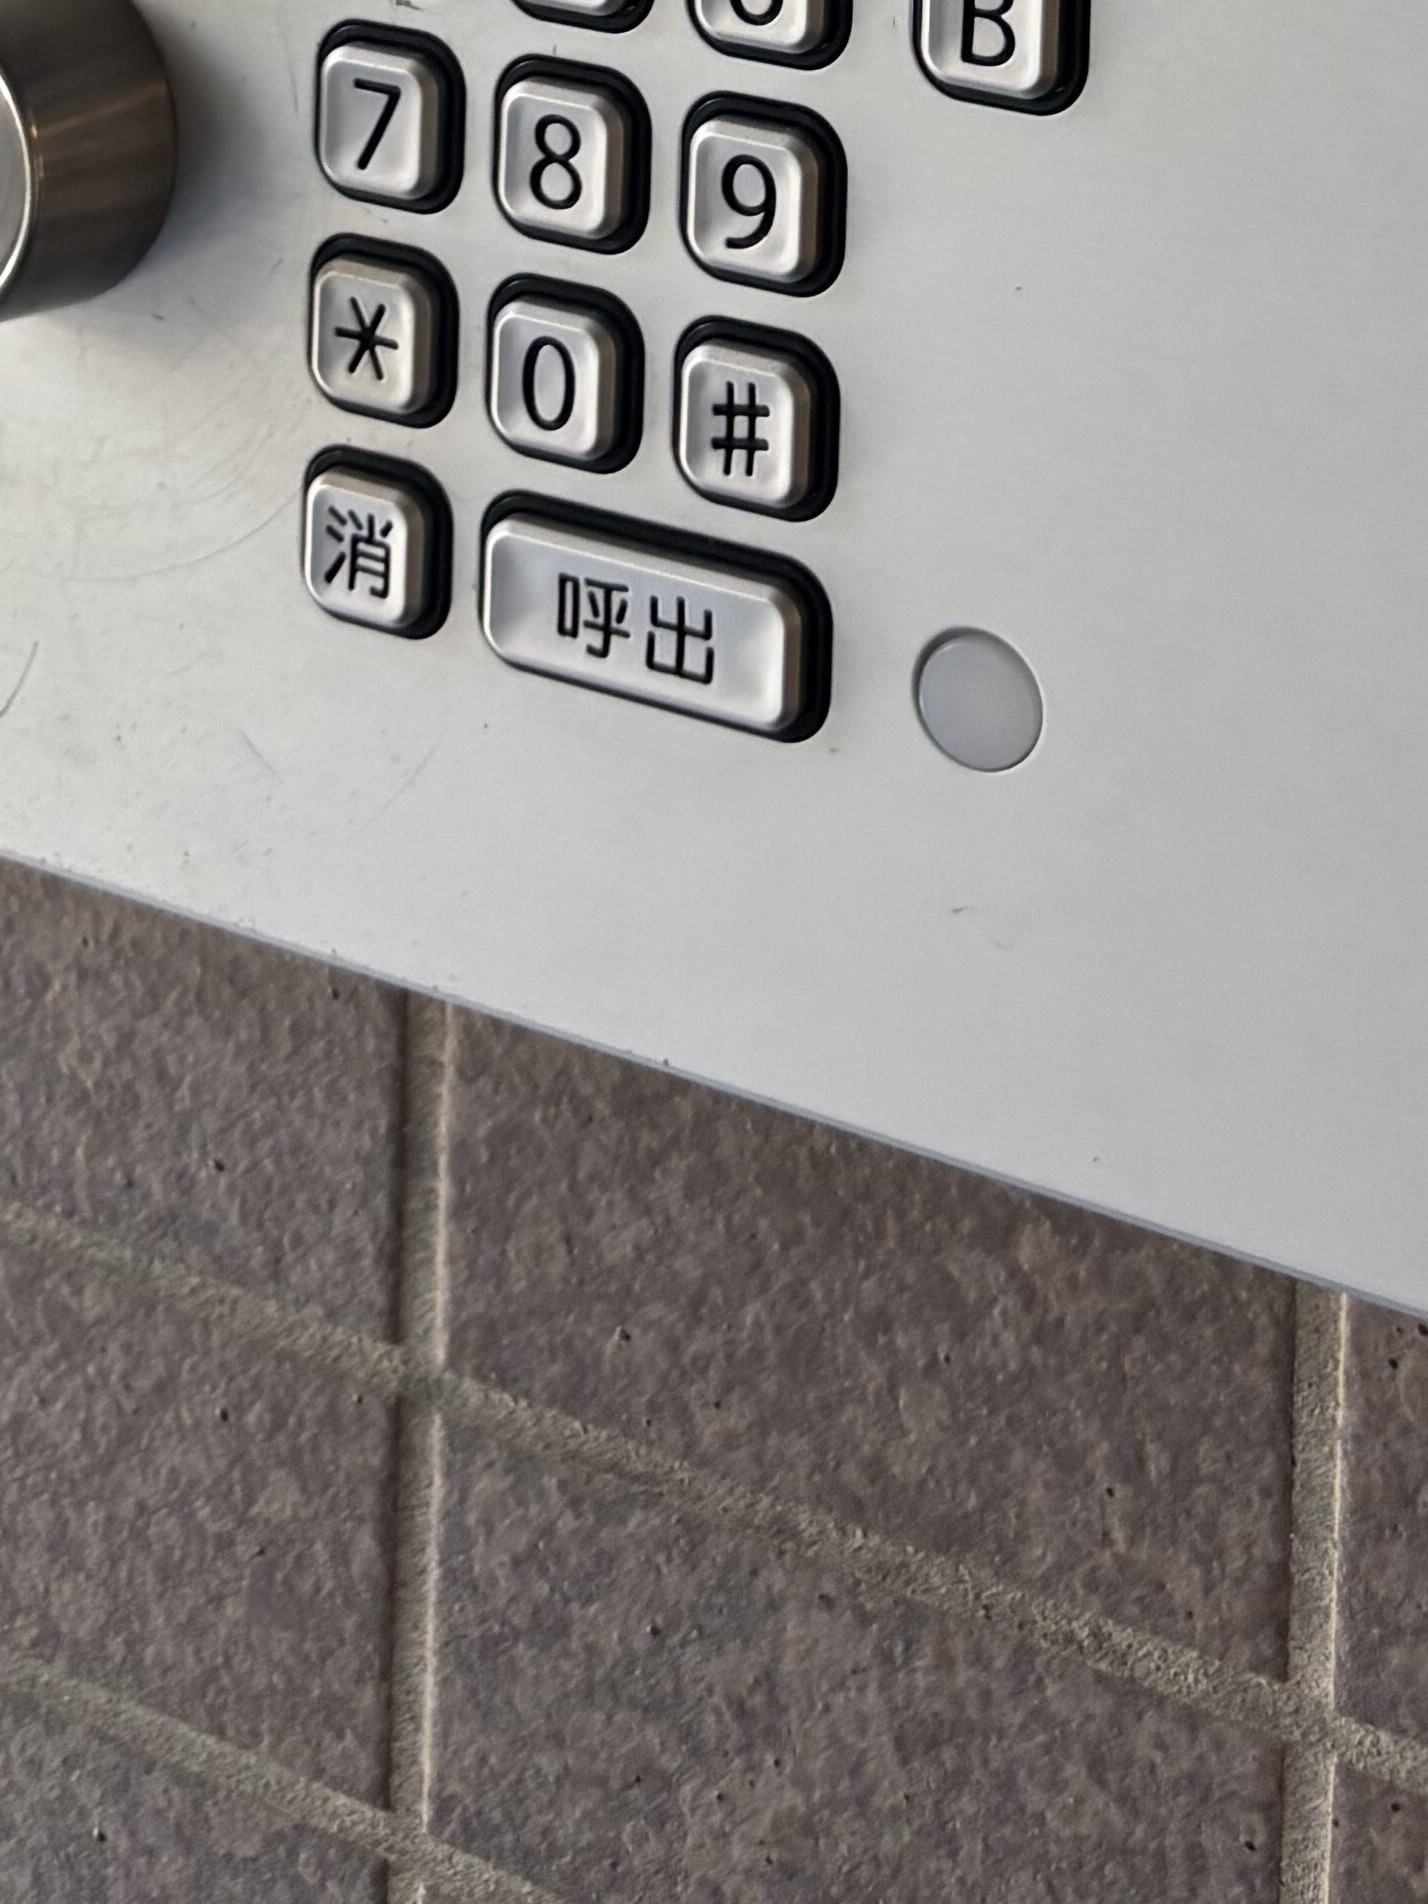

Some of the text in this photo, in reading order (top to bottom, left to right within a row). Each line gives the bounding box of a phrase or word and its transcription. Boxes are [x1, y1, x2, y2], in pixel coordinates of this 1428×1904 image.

[353, 78, 776, 249] 7 8 9
[522, 336, 575, 431] 0
[710, 381, 769, 476] #
[324, 506, 715, 686] 消 呼出
